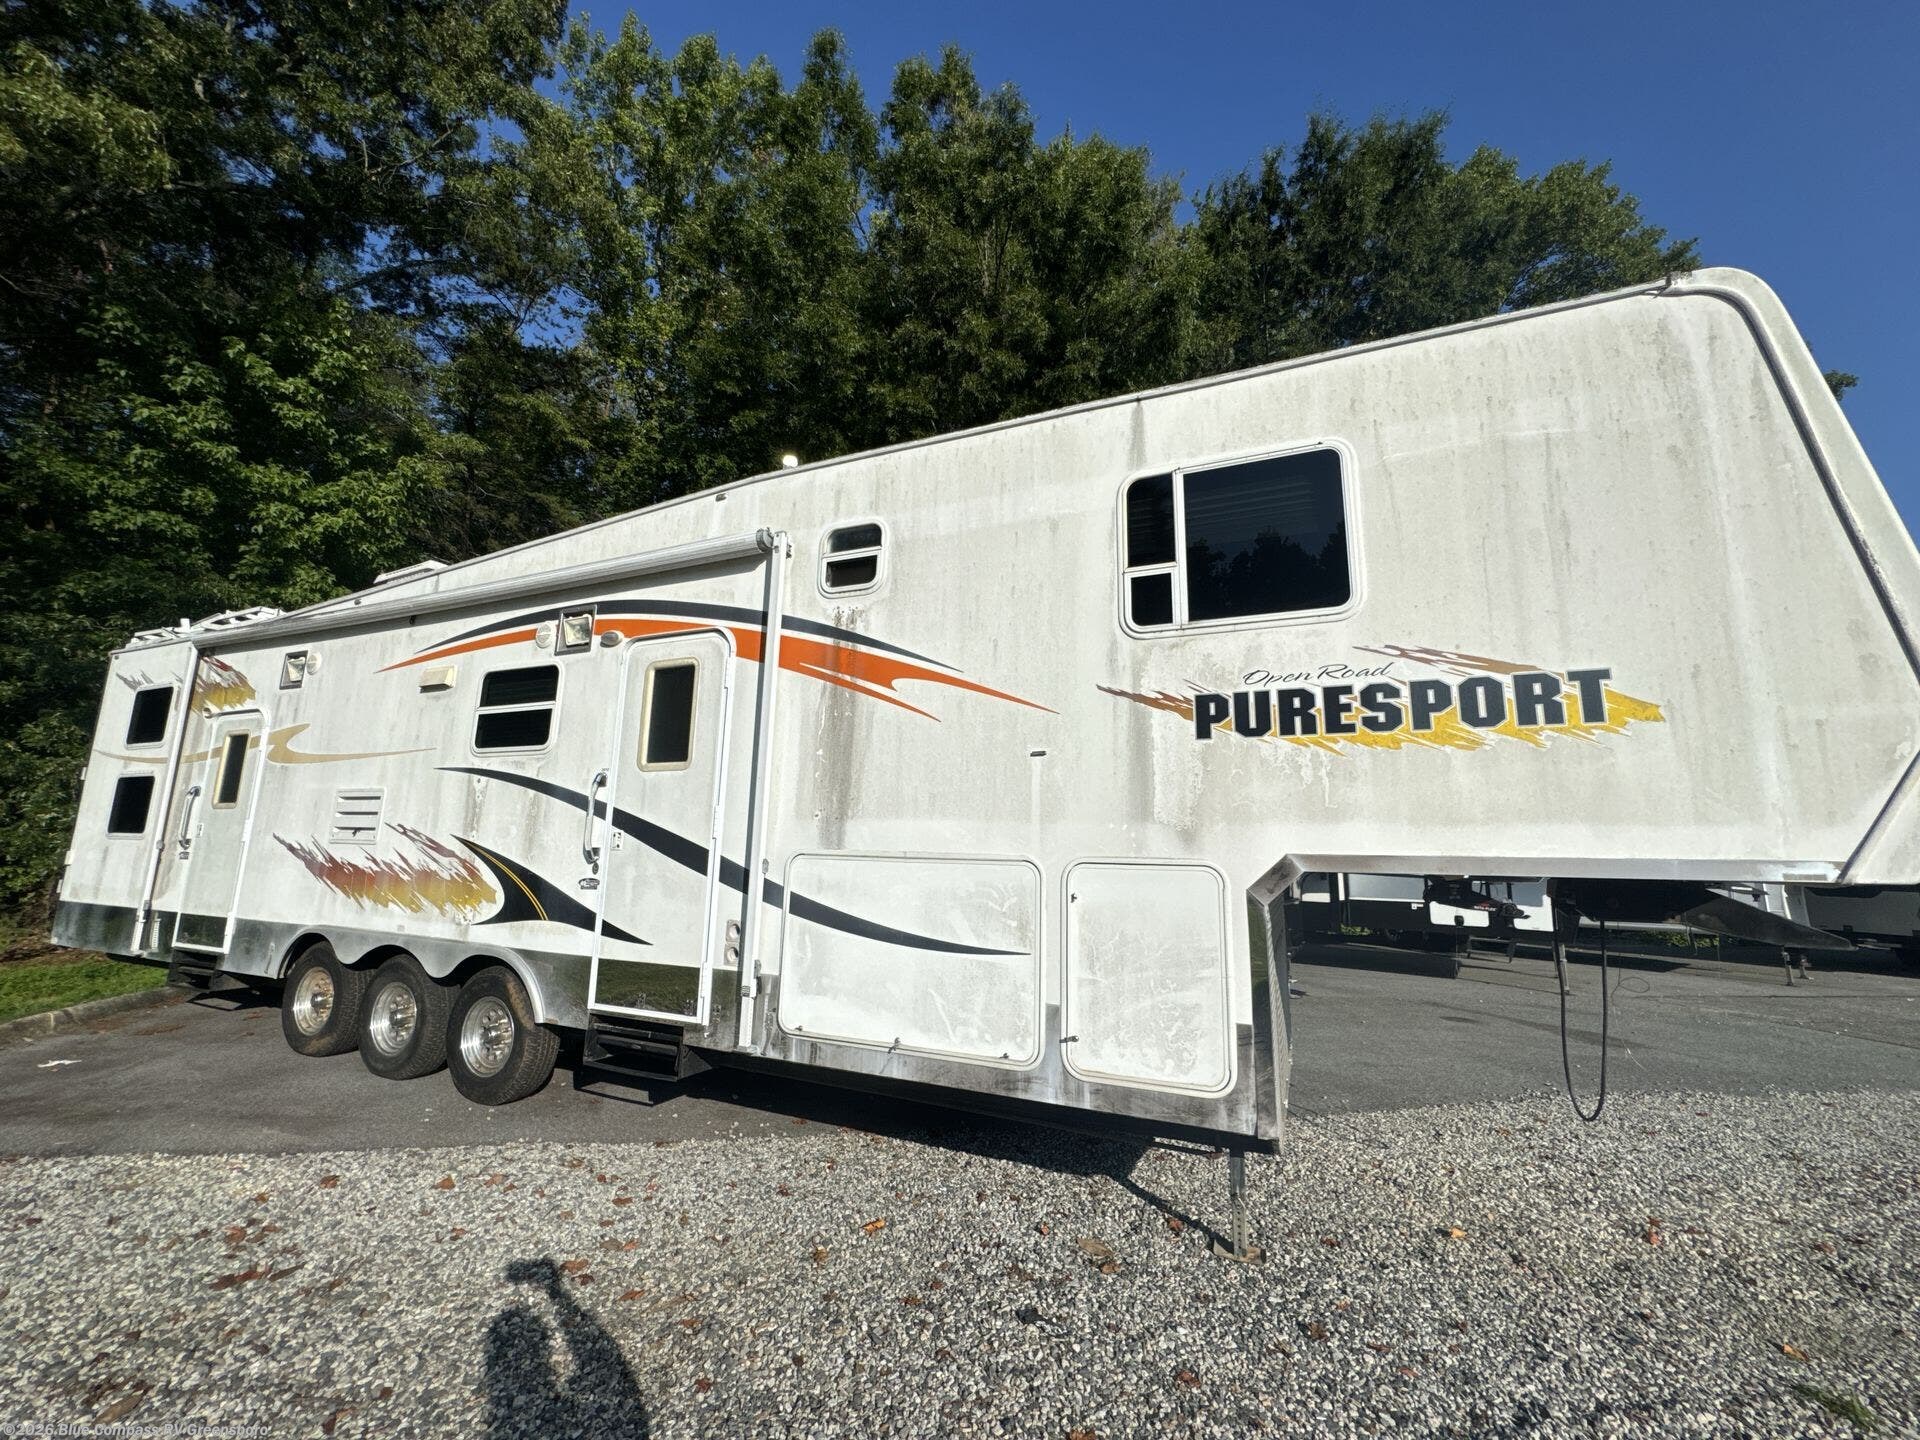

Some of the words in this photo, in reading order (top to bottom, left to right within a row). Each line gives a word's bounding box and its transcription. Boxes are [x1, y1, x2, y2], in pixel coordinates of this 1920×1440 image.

[1242, 669, 1314, 688] Open
[1317, 661, 1395, 680] Road
[1194, 668, 1612, 739] PURESPORT
